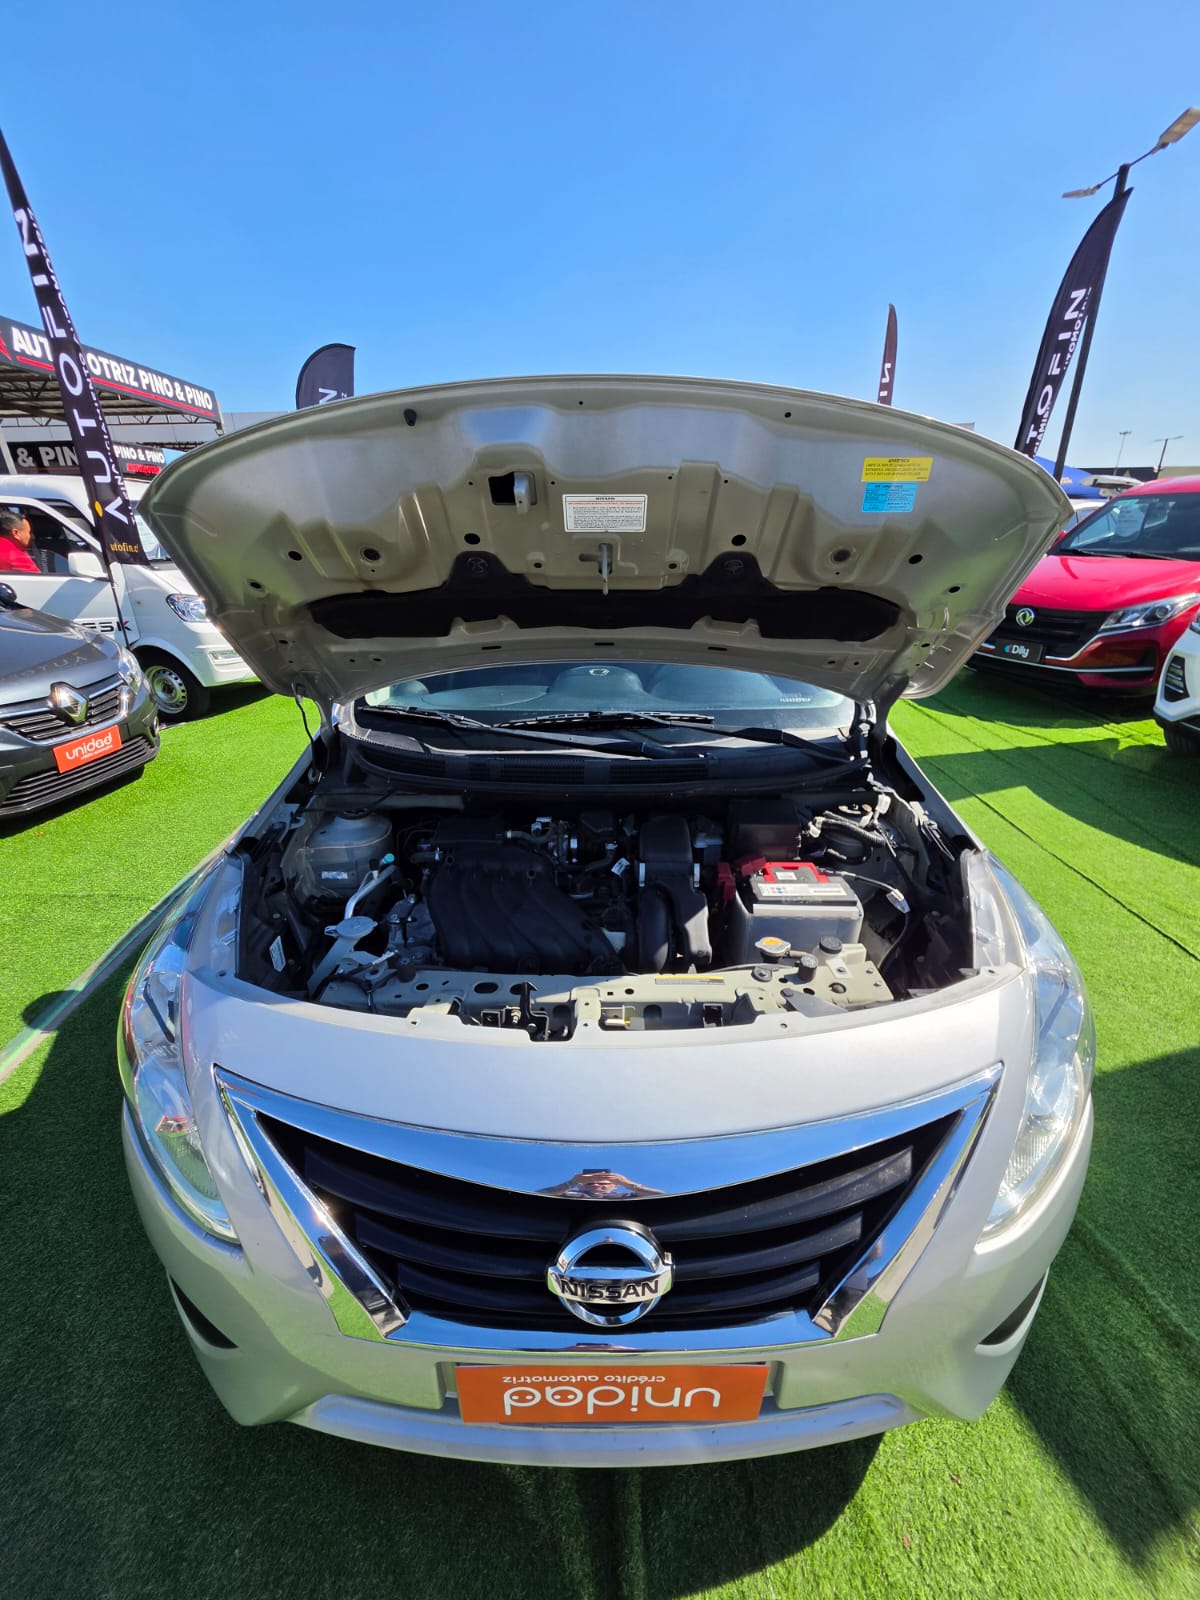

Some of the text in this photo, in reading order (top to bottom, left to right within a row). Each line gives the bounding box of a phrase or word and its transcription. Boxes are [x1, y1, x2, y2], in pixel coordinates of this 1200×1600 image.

[10, 326, 213, 411] AUTOTRIZ PINO & PINO
[14, 207, 130, 525] AUTOFIN
[1023, 288, 1087, 457] TOFIN
[16, 446, 79, 468] & PIN
[112, 445, 137, 460] PINO
[145, 449, 165, 464] PINO
[65, 732, 112, 760] unidad
[560, 1280, 660, 1300] NISSAN
[502, 1375, 667, 1385] crédito automotriz
[503, 1386, 721, 1416] unidad
